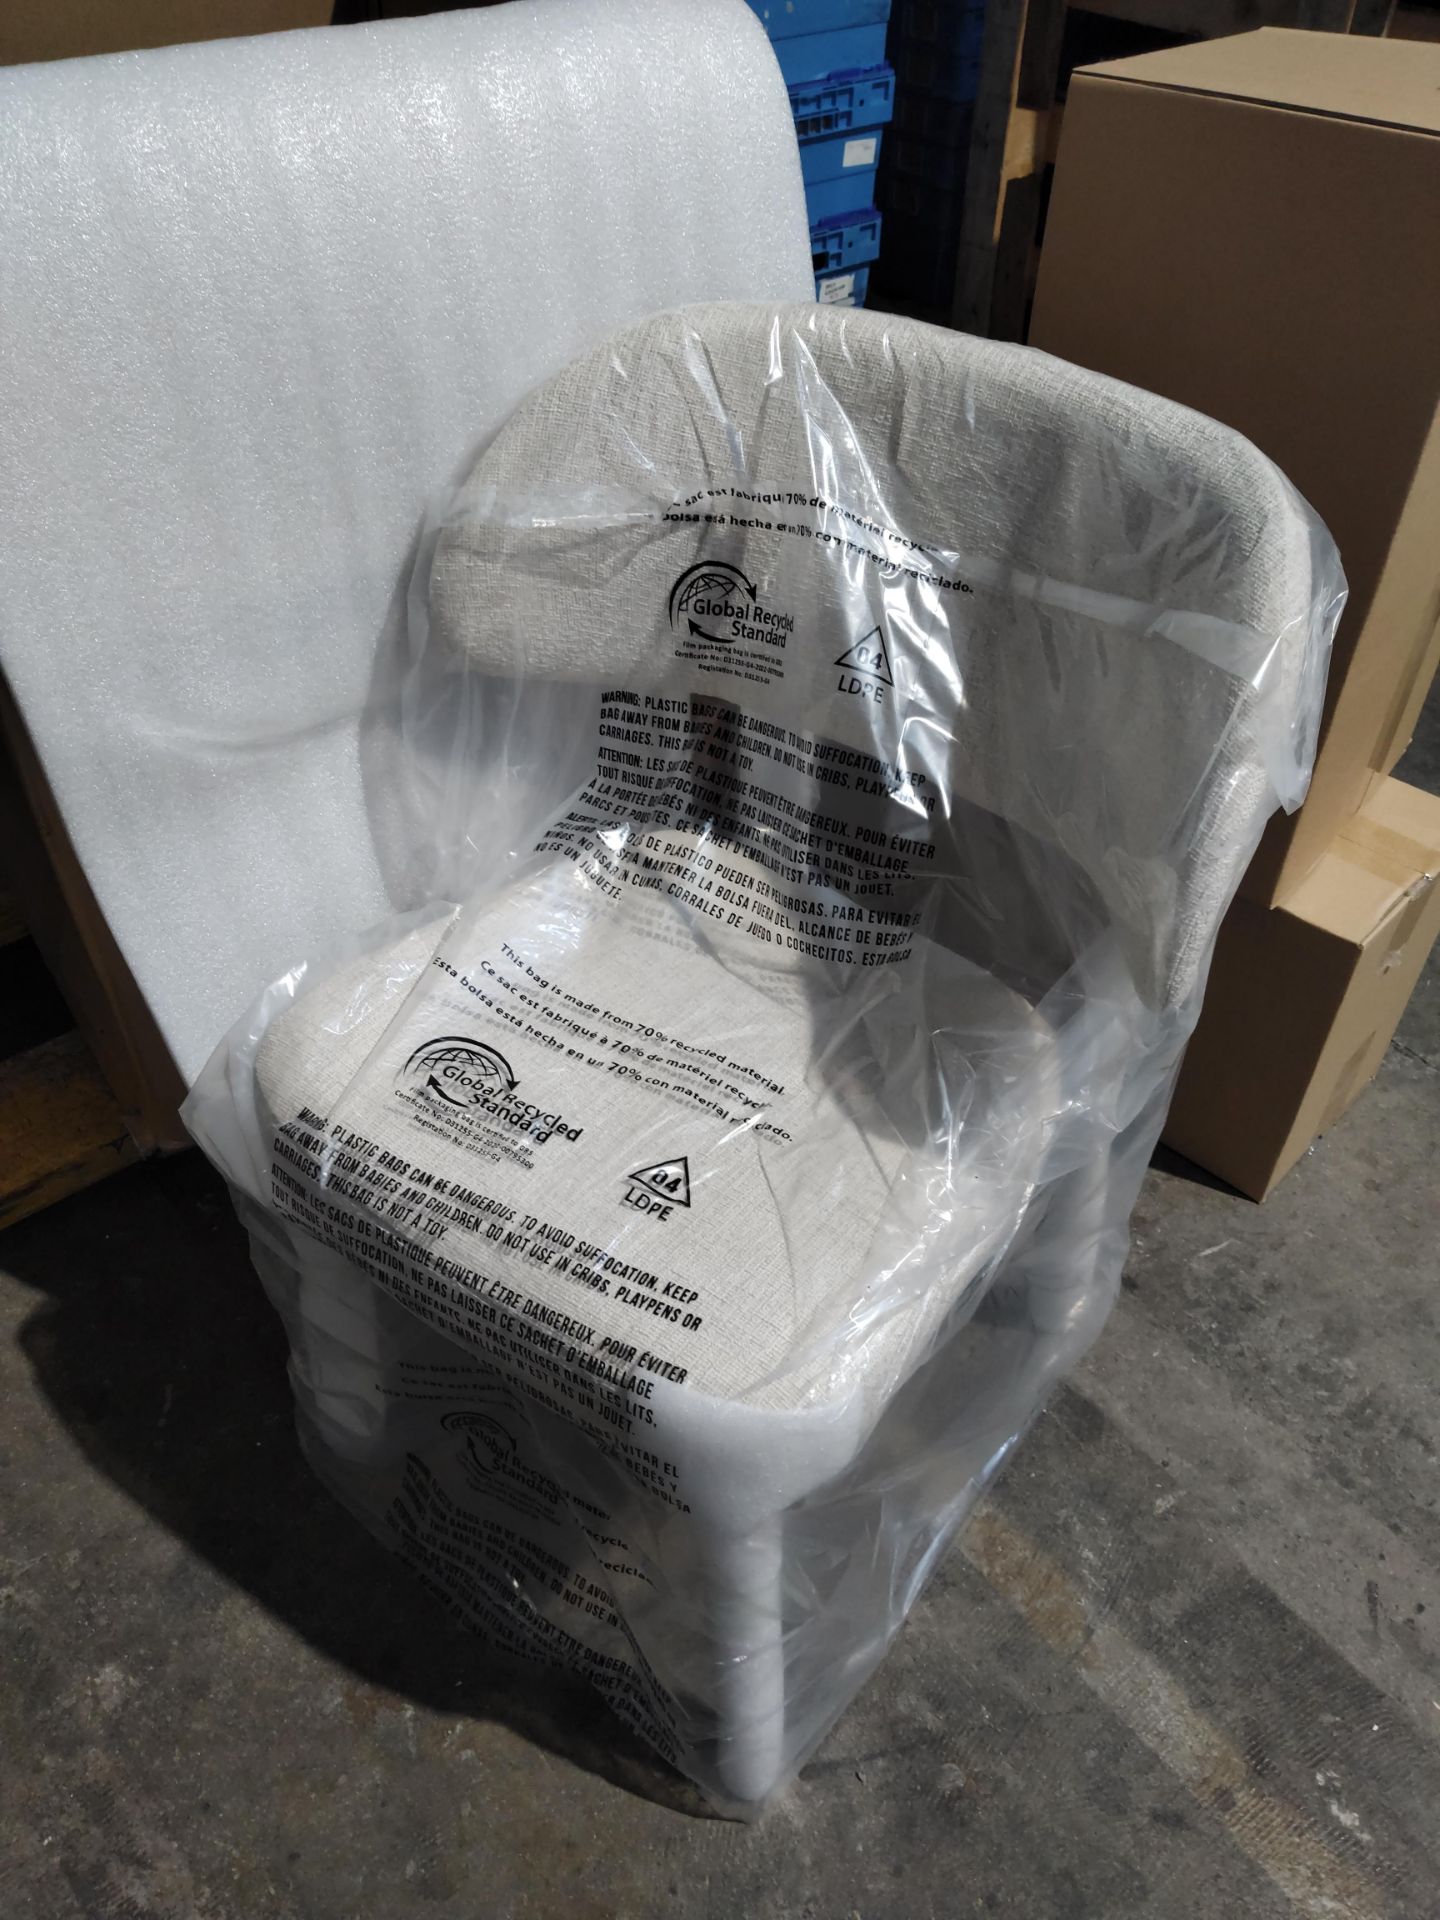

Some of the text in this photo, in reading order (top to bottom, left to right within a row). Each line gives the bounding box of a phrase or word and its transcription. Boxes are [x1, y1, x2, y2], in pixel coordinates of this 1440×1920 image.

[730, 515, 772, 530] hecha
[810, 497, 827, 508] de
[694, 598, 794, 632] Global Recycled
[731, 620, 787, 648] Standard
[674, 650, 709, 660] Certificate
[698, 642, 743, 656] packaging bag
[856, 646, 882, 670] 04
[645, 696, 748, 729] PLASTIC BAGS CAN BE
[837, 674, 884, 704] LDPE
[599, 724, 754, 772] CARRIAGES. THIS IS NOT A TOY.
[600, 708, 796, 769] BAG AWAY FROM AND DO NOT
[596, 764, 910, 874] TOUT RISQUE NE PAS D'EMBALLAGE
[598, 783, 880, 881] LA PORTÉE NI DES DANS LES
[646, 756, 936, 860] LES DE PLASTIQUE PEUVENT POUR ÉVITER
[563, 846, 582, 862] UN
[578, 792, 895, 897] PARCS ET CE PAS UN JOUET.
[577, 836, 594, 851] NO
[593, 850, 620, 876] USAR
[667, 883, 725, 920] CORRALES
[726, 912, 744, 928] DE
[746, 921, 772, 943] JUEGO
[776, 933, 782, 945] O
[786, 936, 857, 965] COCHECITOS.
[642, 856, 872, 945] MANTENER LA BOLSA FUERA ALCANCE DE
[646, 836, 662, 849] DE
[664, 842, 713, 870] PLÁSTICO
[714, 864, 754, 890] PUEDEN
[756, 880, 770, 898] SER
[832, 904, 864, 922] PARA
[868, 910, 912, 928] EVITAR
[480, 960, 724, 1087] Ce sac est fabriqué à de matériel
[500, 942, 727, 1064] This bag is made from 70% recycled
[460, 976, 730, 1120] bolsa está hecha en 70% con material
[394, 1090, 430, 1114] Certificate
[442, 1065, 584, 1143] Global Recycled
[468, 1093, 554, 1144] Standard
[624, 1186, 675, 1222] LDPE
[651, 1169, 682, 1193] 04
[278, 1122, 703, 1332] BAG AWAY FROM BABIES AND CHILDREN. DO NOT USE IN CRIBS, PLAYPENS OR
[326, 1172, 449, 1242] THIS BAG IS NOT A TOY.
[330, 1124, 700, 1304] PLASTIC BAGS CAN BE DANGEROUS. TO AVOID KEEP
[271, 1181, 290, 1206] TOUT
[322, 1220, 335, 1238] DE
[410, 1268, 424, 1286] NE
[427, 1276, 448, 1298] PAS
[450, 1288, 496, 1325] LAISSER
[500, 1312, 516, 1333] CE
[516, 1322, 566, 1357] SACHET
[565, 1346, 655, 1400] D'EMBALLAGE
[310, 1193, 326, 1215] LES
[328, 1206, 354, 1230] SACS
[358, 1220, 372, 1238] DE
[375, 1224, 434, 1268] PLASTIQUE
[433, 1256, 490, 1293] PEUVENT
[488, 1280, 523, 1310] ÊTRE
[522, 1298, 597, 1347] DANGEREUX.
[600, 1336, 638, 1363] POUR
[637, 1350, 688, 1385] ÉVITER
[578, 1392, 595, 1410] UN
[598, 1386, 658, 1428] LES LITS.
[663, 1462, 680, 1479] EL
[562, 1588, 585, 1609] NOT
[584, 1600, 607, 1620] USE
[572, 1572, 586, 1590] TO
